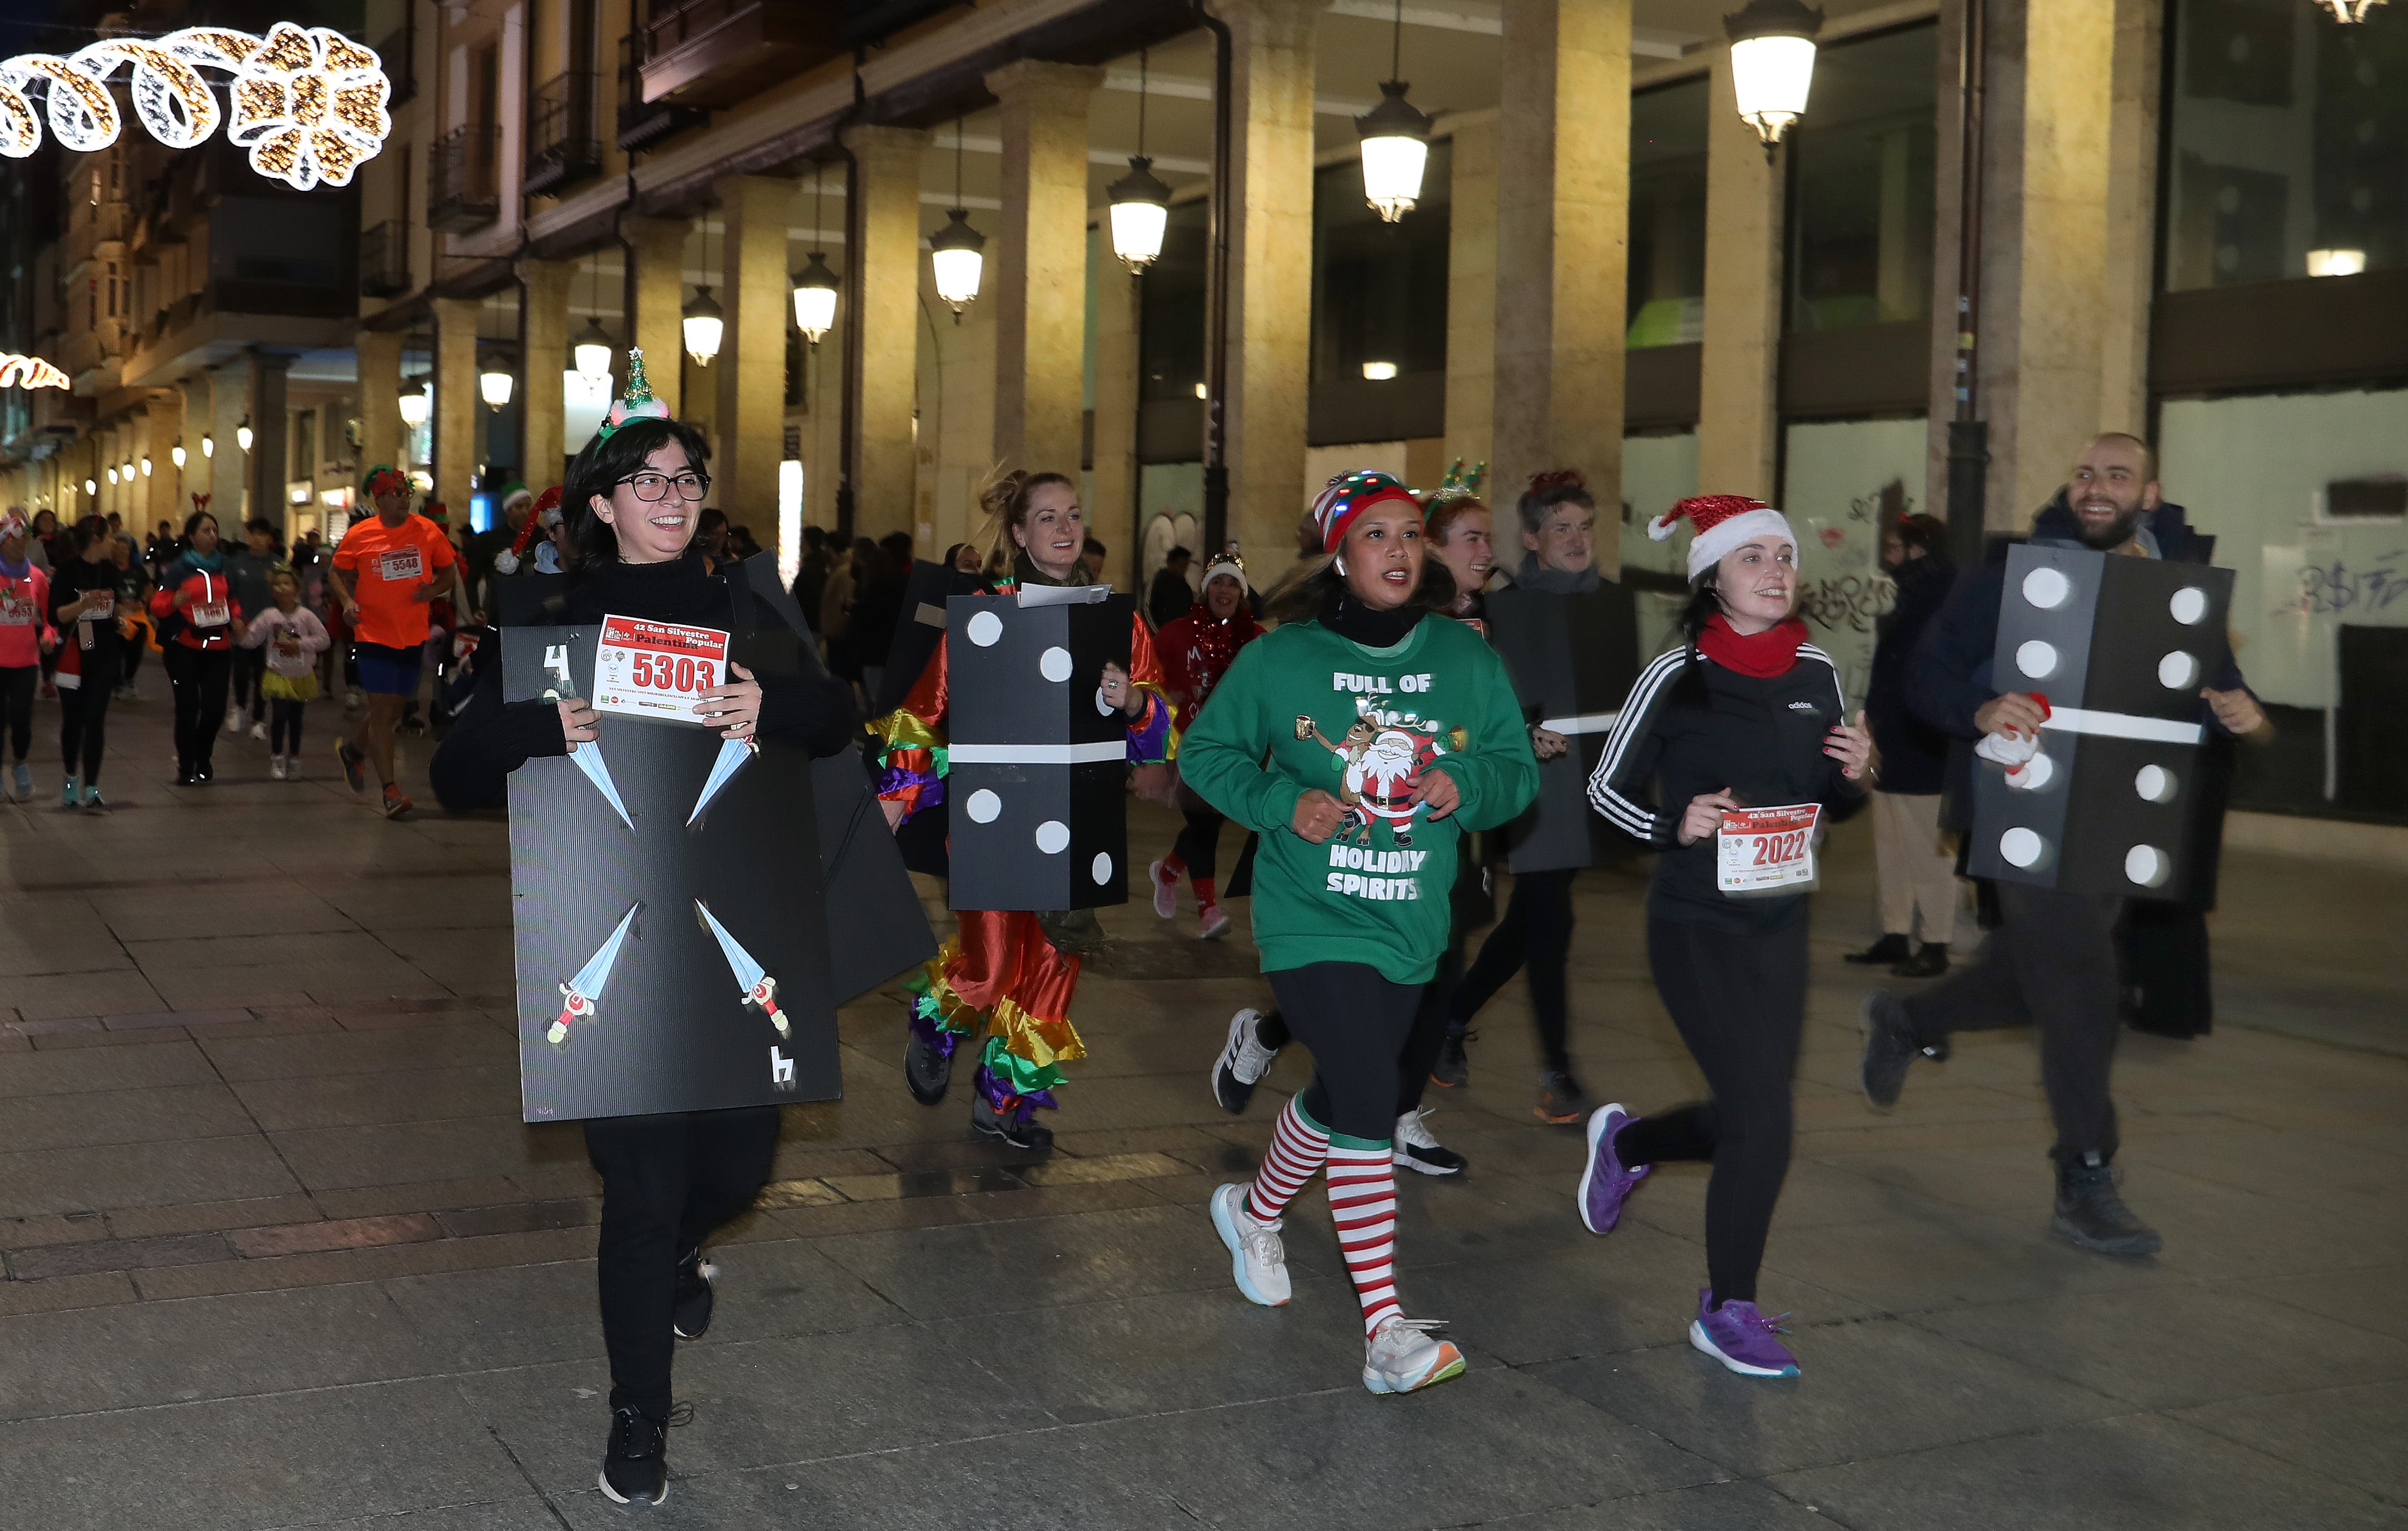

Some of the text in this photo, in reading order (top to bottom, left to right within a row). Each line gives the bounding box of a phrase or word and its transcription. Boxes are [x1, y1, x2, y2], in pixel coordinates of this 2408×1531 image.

[646, 624, 665, 633] San
[666, 628, 710, 639] Silvestre
[636, 634, 698, 650] Palentina
[685, 637, 724, 649] Popular
[543, 644, 570, 682] 4
[632, 652, 714, 693] 5303
[1333, 672, 1433, 694] FULL OF
[1788, 700, 1813, 709] adidas
[1776, 809, 1807, 817] Silvestre
[1790, 812, 1814, 822] Popular
[1752, 831, 1805, 866] 2022
[1329, 844, 1427, 873] HOLIDAY
[1326, 873, 1419, 901] SPIRITS
